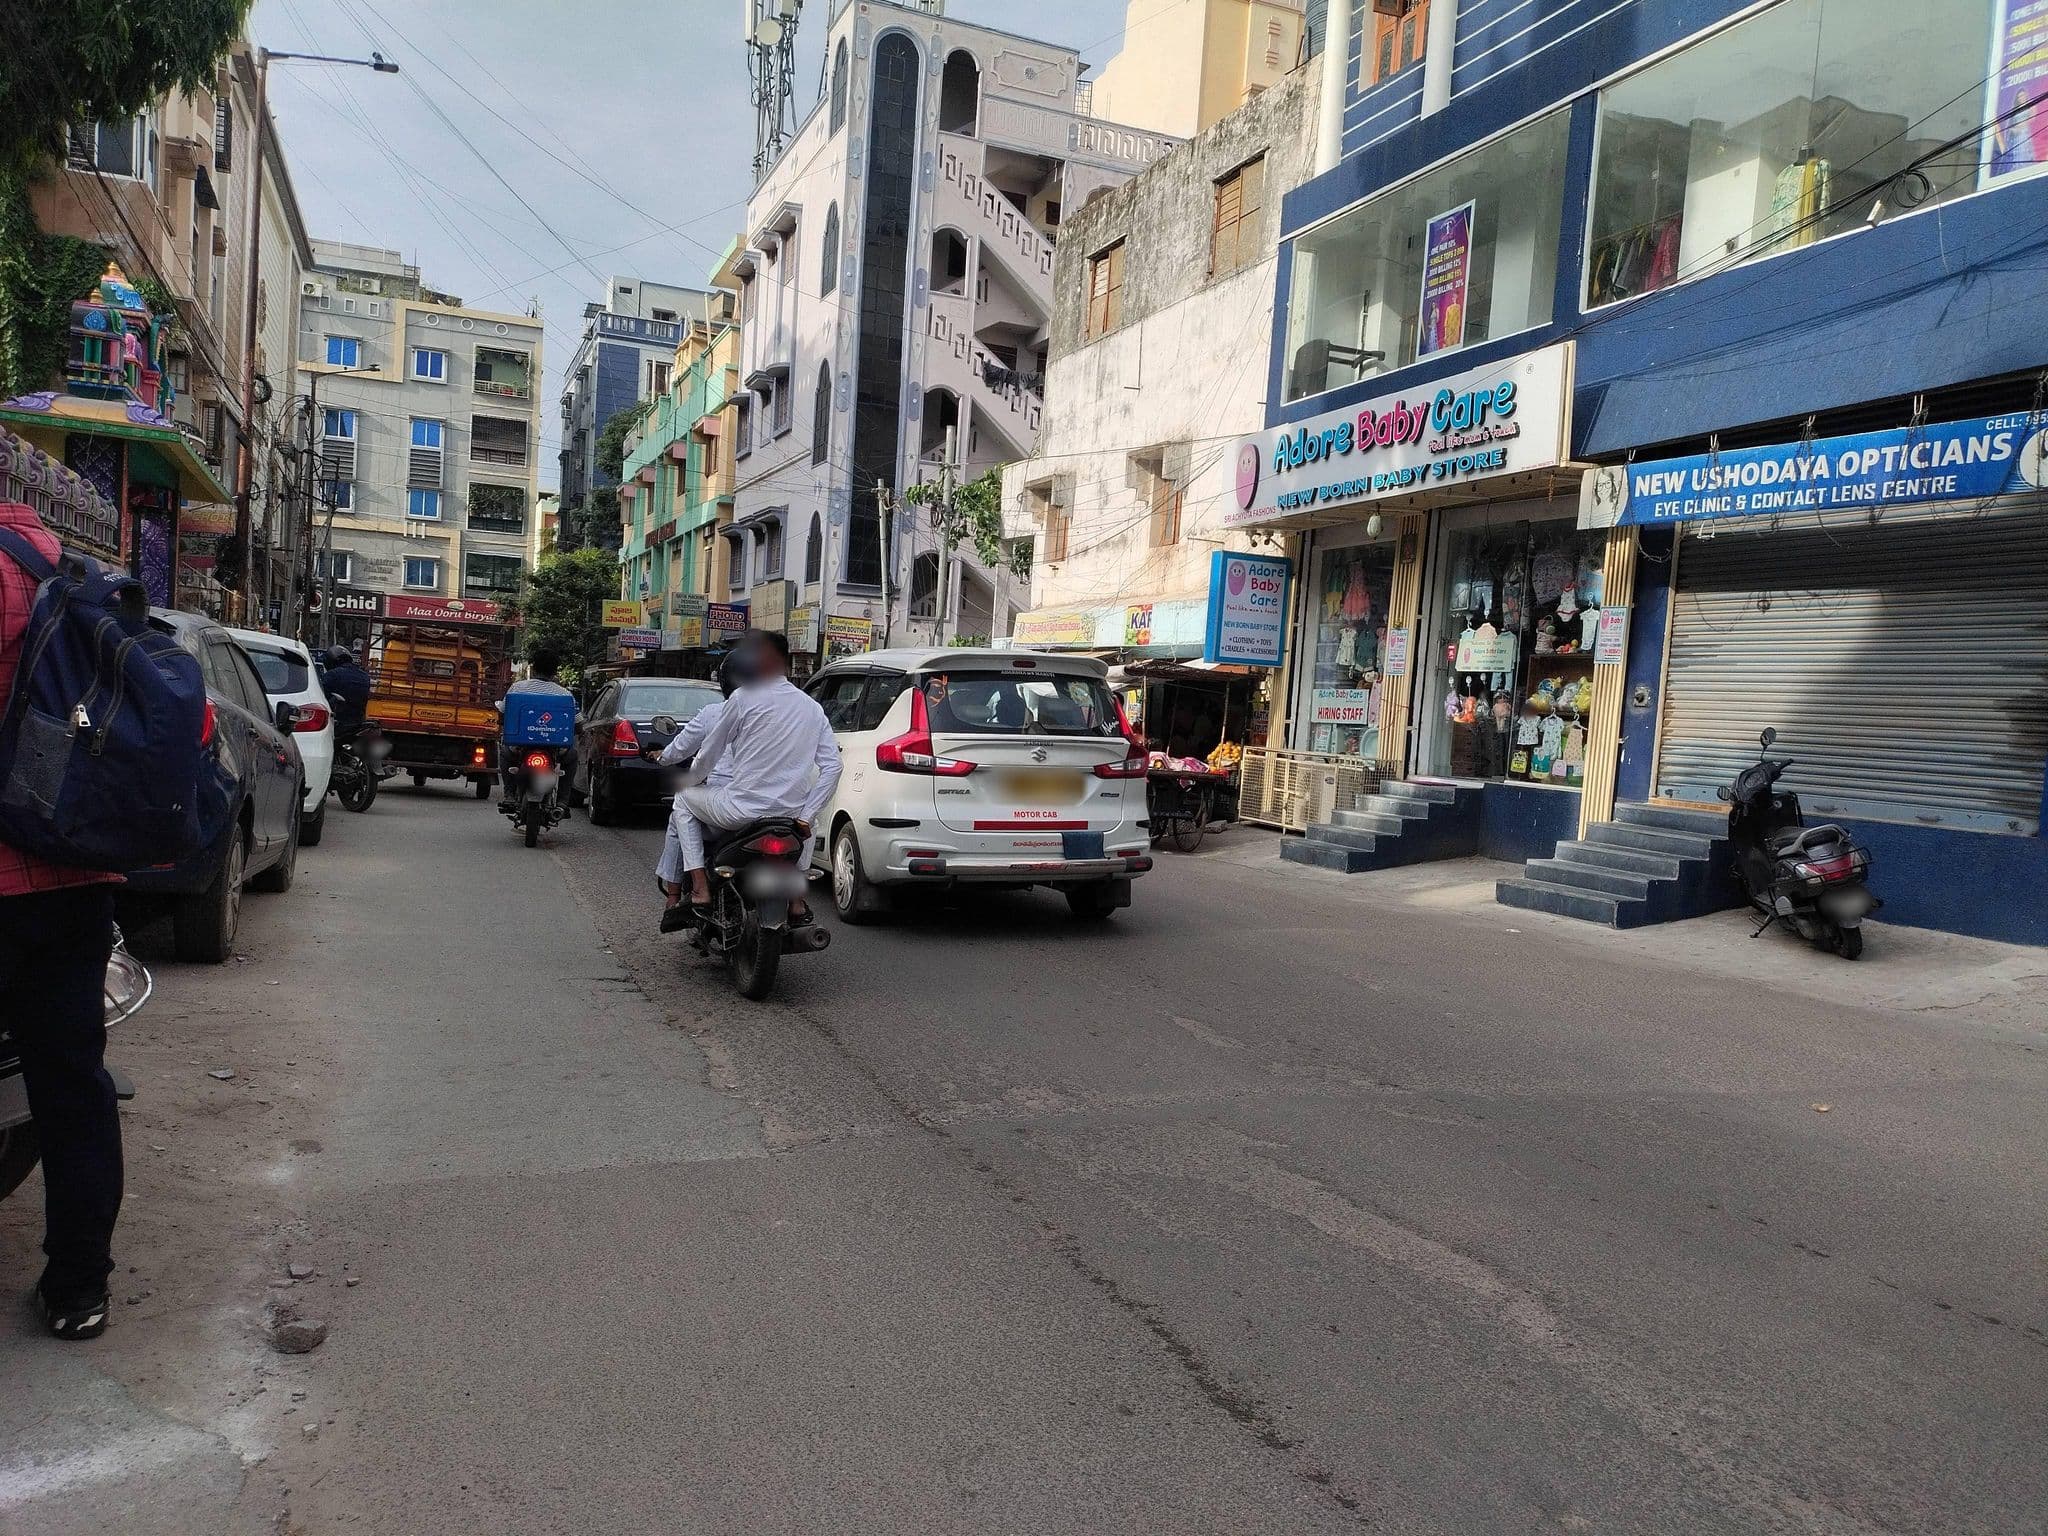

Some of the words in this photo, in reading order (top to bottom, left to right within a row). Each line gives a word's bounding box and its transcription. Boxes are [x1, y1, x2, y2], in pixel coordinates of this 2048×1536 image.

[1274, 421, 1351, 472] Adore
[1356, 399, 1428, 450] Baby
[1431, 380, 1515, 433] Care
[1986, 417, 2021, 431] CELL:
[1634, 470, 1686, 498] NEW
[1691, 454, 1829, 492] USHODAYA
[1838, 432, 2012, 478] OPTICIANS
[1277, 489, 1314, 508] NEW
[1319, 475, 1368, 500] BORN
[1372, 465, 1425, 490] BABY
[1432, 449, 1503, 478] STORE
[1655, 501, 1681, 518] EYE
[1684, 495, 1730, 515] CLINIC
[1736, 495, 1747, 511] &
[1751, 488, 1827, 510] CONTACT
[1831, 482, 1876, 503] LENS
[1882, 474, 1958, 499] CENTRE
[1249, 564, 1284, 578] Adore
[1251, 577, 1281, 593] Baby
[1250, 593, 1278, 606] Care
[406, 606, 432, 616] Maa
[434, 608, 462, 618] Ooru
[709, 610, 745, 621] PHOTO
[708, 619, 746, 630] FRAMES
[847, 626, 870, 634] BOUTIQUE
[1224, 620, 1235, 628] NEW
[1235, 621, 1249, 629] BORN
[1249, 622, 1262, 630] BABY
[1263, 623, 1278, 632] STORE
[1232, 636, 1255, 645] CLOTHING
[1260, 638, 1272, 646] TOYS
[1250, 648, 1278, 656] ACCESSORIES
[1319, 689, 1335, 699] Adore
[1336, 689, 1349, 699] Baby
[1349, 690, 1363, 699] Care
[1318, 707, 1341, 720] HIRING
[1342, 707, 1364, 720] STAFF
